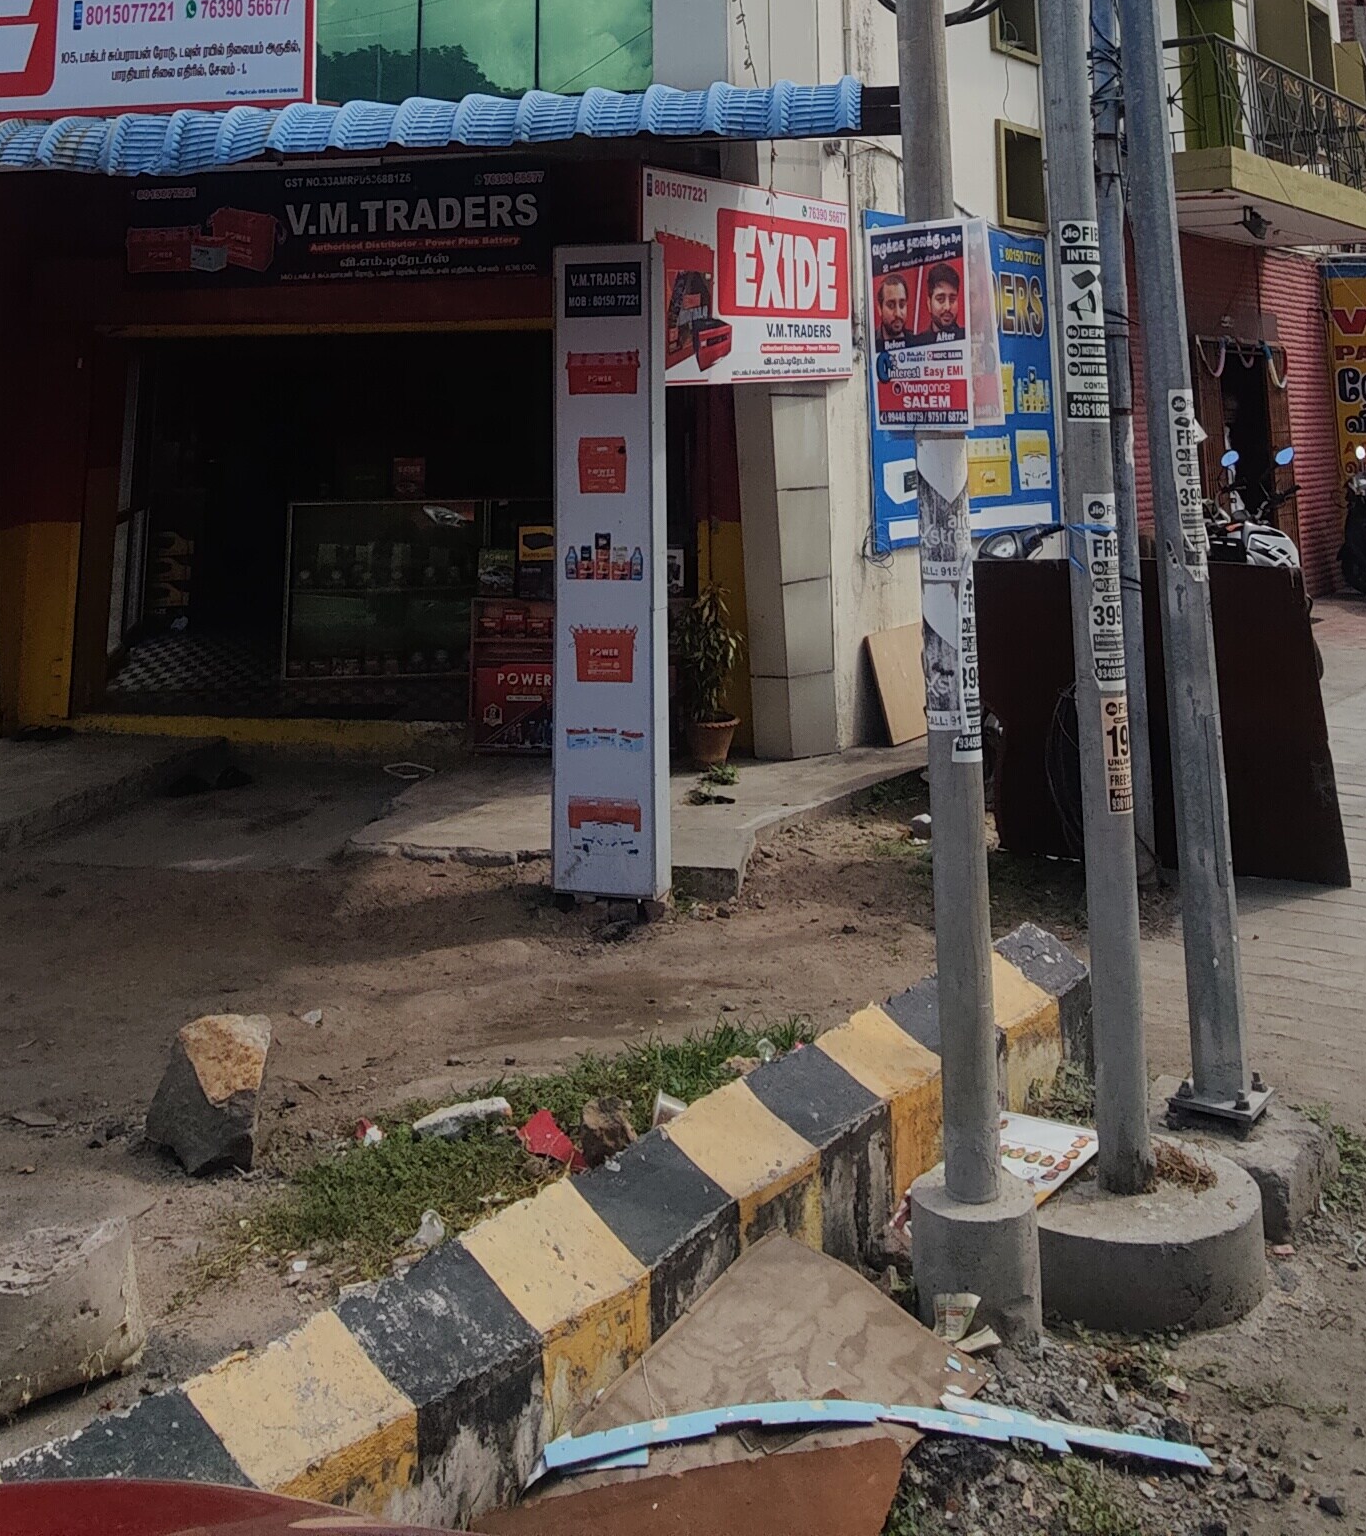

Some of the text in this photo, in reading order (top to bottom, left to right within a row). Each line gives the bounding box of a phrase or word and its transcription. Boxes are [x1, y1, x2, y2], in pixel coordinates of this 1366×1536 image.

[86, 1, 174, 26] 8015077221
[208, 61, 235, 77] சேலம்
[285, 177, 303, 189] GST
[654, 179, 708, 203] 8015077221
[285, 192, 539, 236] V.M.TRADERS
[808, 207, 828, 222] 76390
[1062, 228, 1080, 239] Jio
[310, 235, 520, 253] Authorised Distributor Power Plus Battery
[733, 225, 837, 311] EXIDE
[570, 272, 636, 287] V.M.TRADERS
[568, 296, 587, 308] MOB
[616, 294, 639, 306] 77221
[766, 322, 832, 338] V.M.TRADERS
[936, 332, 956, 342] After
[884, 339, 906, 350] Before
[948, 351, 962, 359] BANK
[888, 365, 964, 379] Interest Easy EMI
[902, 395, 951, 409] SALEM
[1090, 504, 1104, 516] Jio
[589, 648, 619, 657] POWER
[497, 672, 552, 687] POWER
